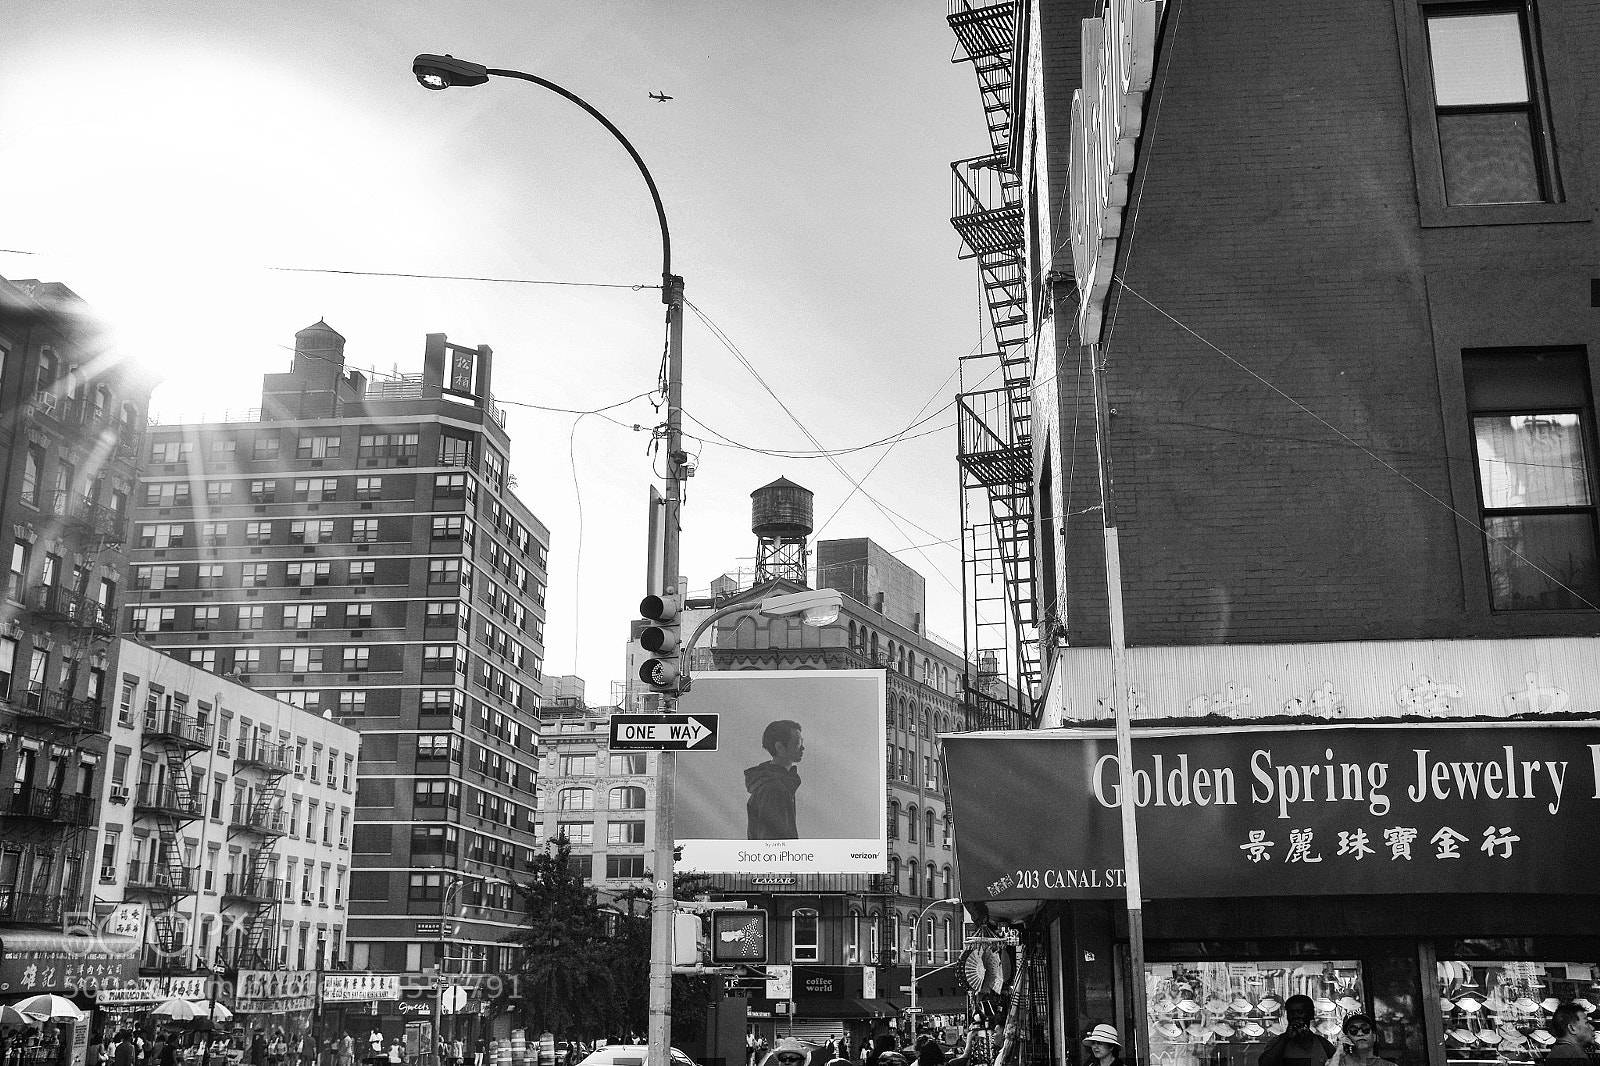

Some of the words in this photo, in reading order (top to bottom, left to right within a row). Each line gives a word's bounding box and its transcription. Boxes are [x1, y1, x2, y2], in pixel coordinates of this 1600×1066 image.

[625, 725, 656, 740] ONE
[670, 725, 702, 740] WAY
[1093, 752, 1237, 808] Golden
[1250, 747, 1392, 819] Spring
[1407, 744, 1568, 816] Jewelry
[1239, 825, 1521, 865] 景麗珠寶金行
[738, 851, 761, 862] Shot
[763, 854, 777, 862] on
[779, 851, 814, 862] iPhone
[850, 852, 877, 860] verizon
[1016, 870, 1040, 889] 203
[1044, 869, 1102, 888] CANAL
[1105, 868, 1126, 888] ST.
